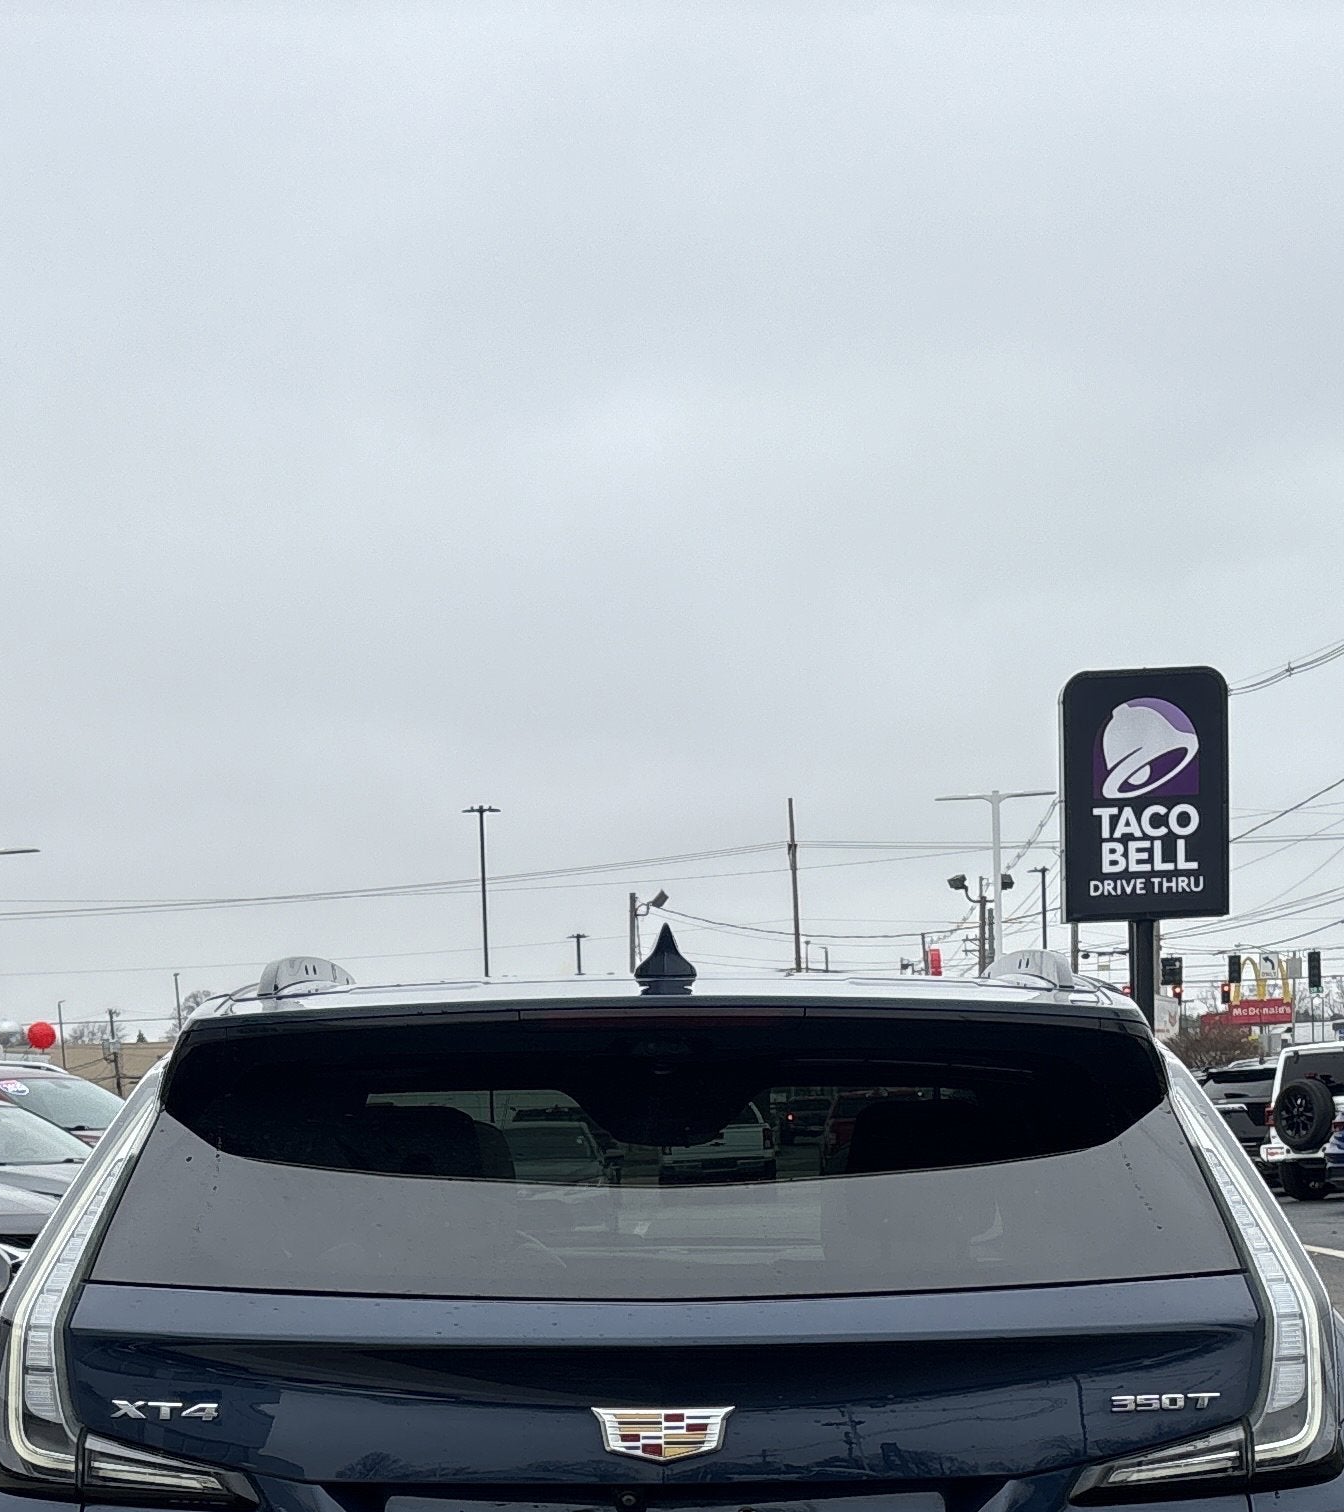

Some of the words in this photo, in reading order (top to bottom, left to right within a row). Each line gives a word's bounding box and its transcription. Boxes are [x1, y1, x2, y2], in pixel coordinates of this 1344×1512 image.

[1093, 803, 1199, 838] TACO
[1102, 839, 1198, 873] BELL
[1090, 878, 1146, 896] DRIVE
[1151, 876, 1203, 893] THRU
[1232, 1005, 1291, 1016] McDonald's
[110, 1399, 218, 1420] XT4
[1111, 1392, 1221, 1412] 350T
